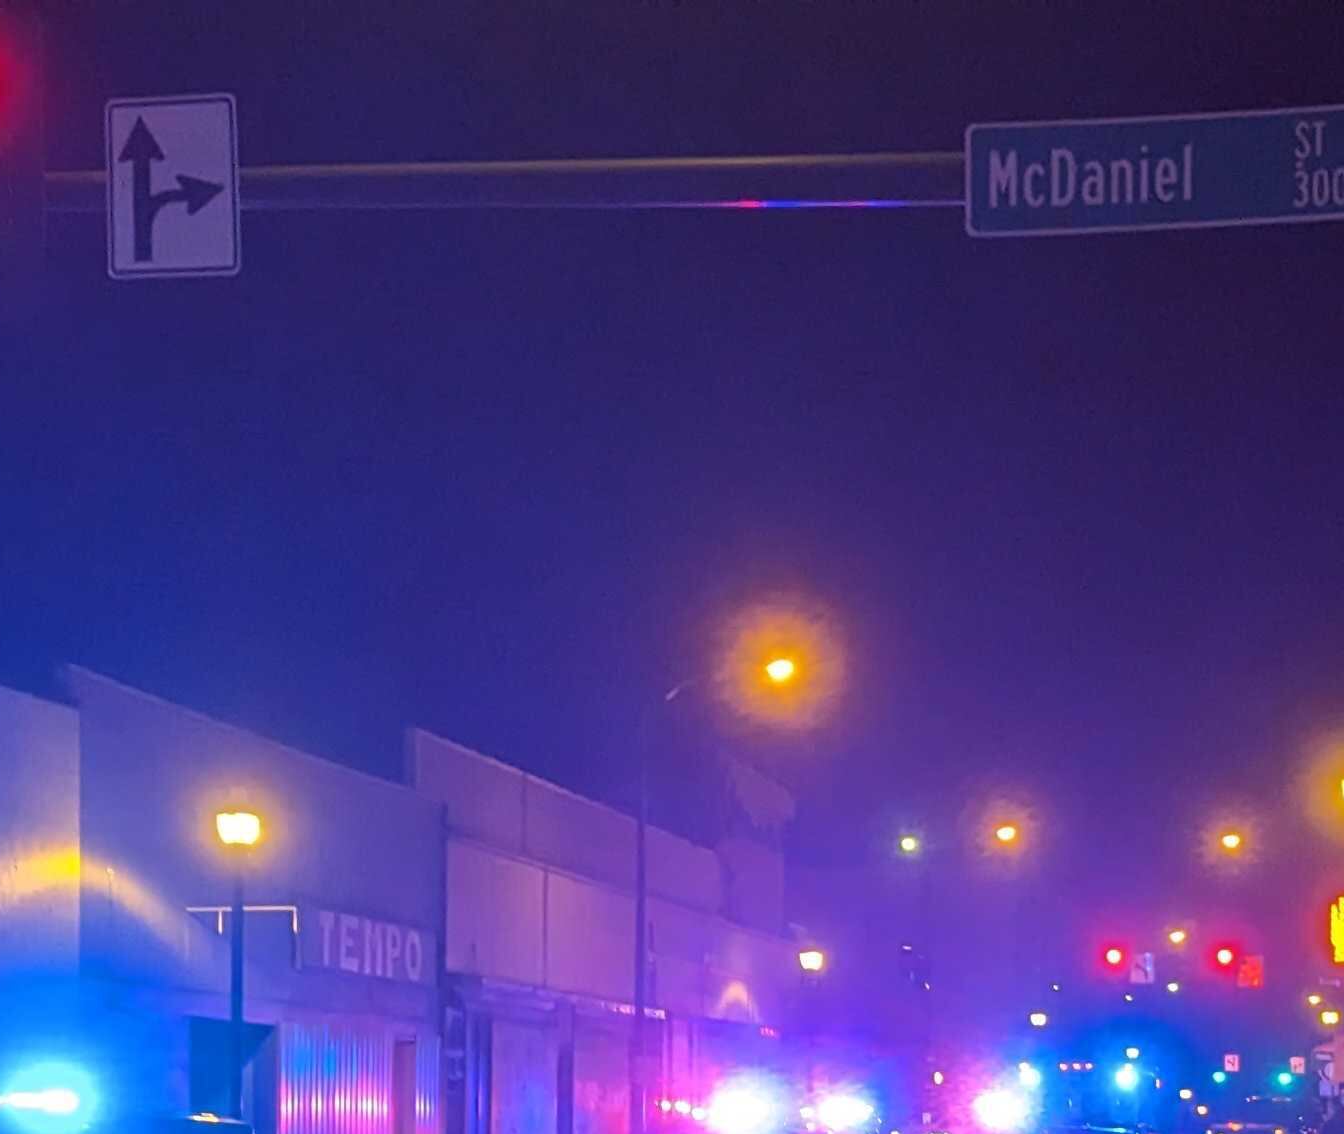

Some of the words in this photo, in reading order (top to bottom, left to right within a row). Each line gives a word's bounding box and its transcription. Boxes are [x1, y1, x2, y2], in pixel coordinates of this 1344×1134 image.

[1295, 121, 1326, 159] ST
[989, 144, 1193, 208] McDaniel
[319, 911, 423, 983] TEMPO
